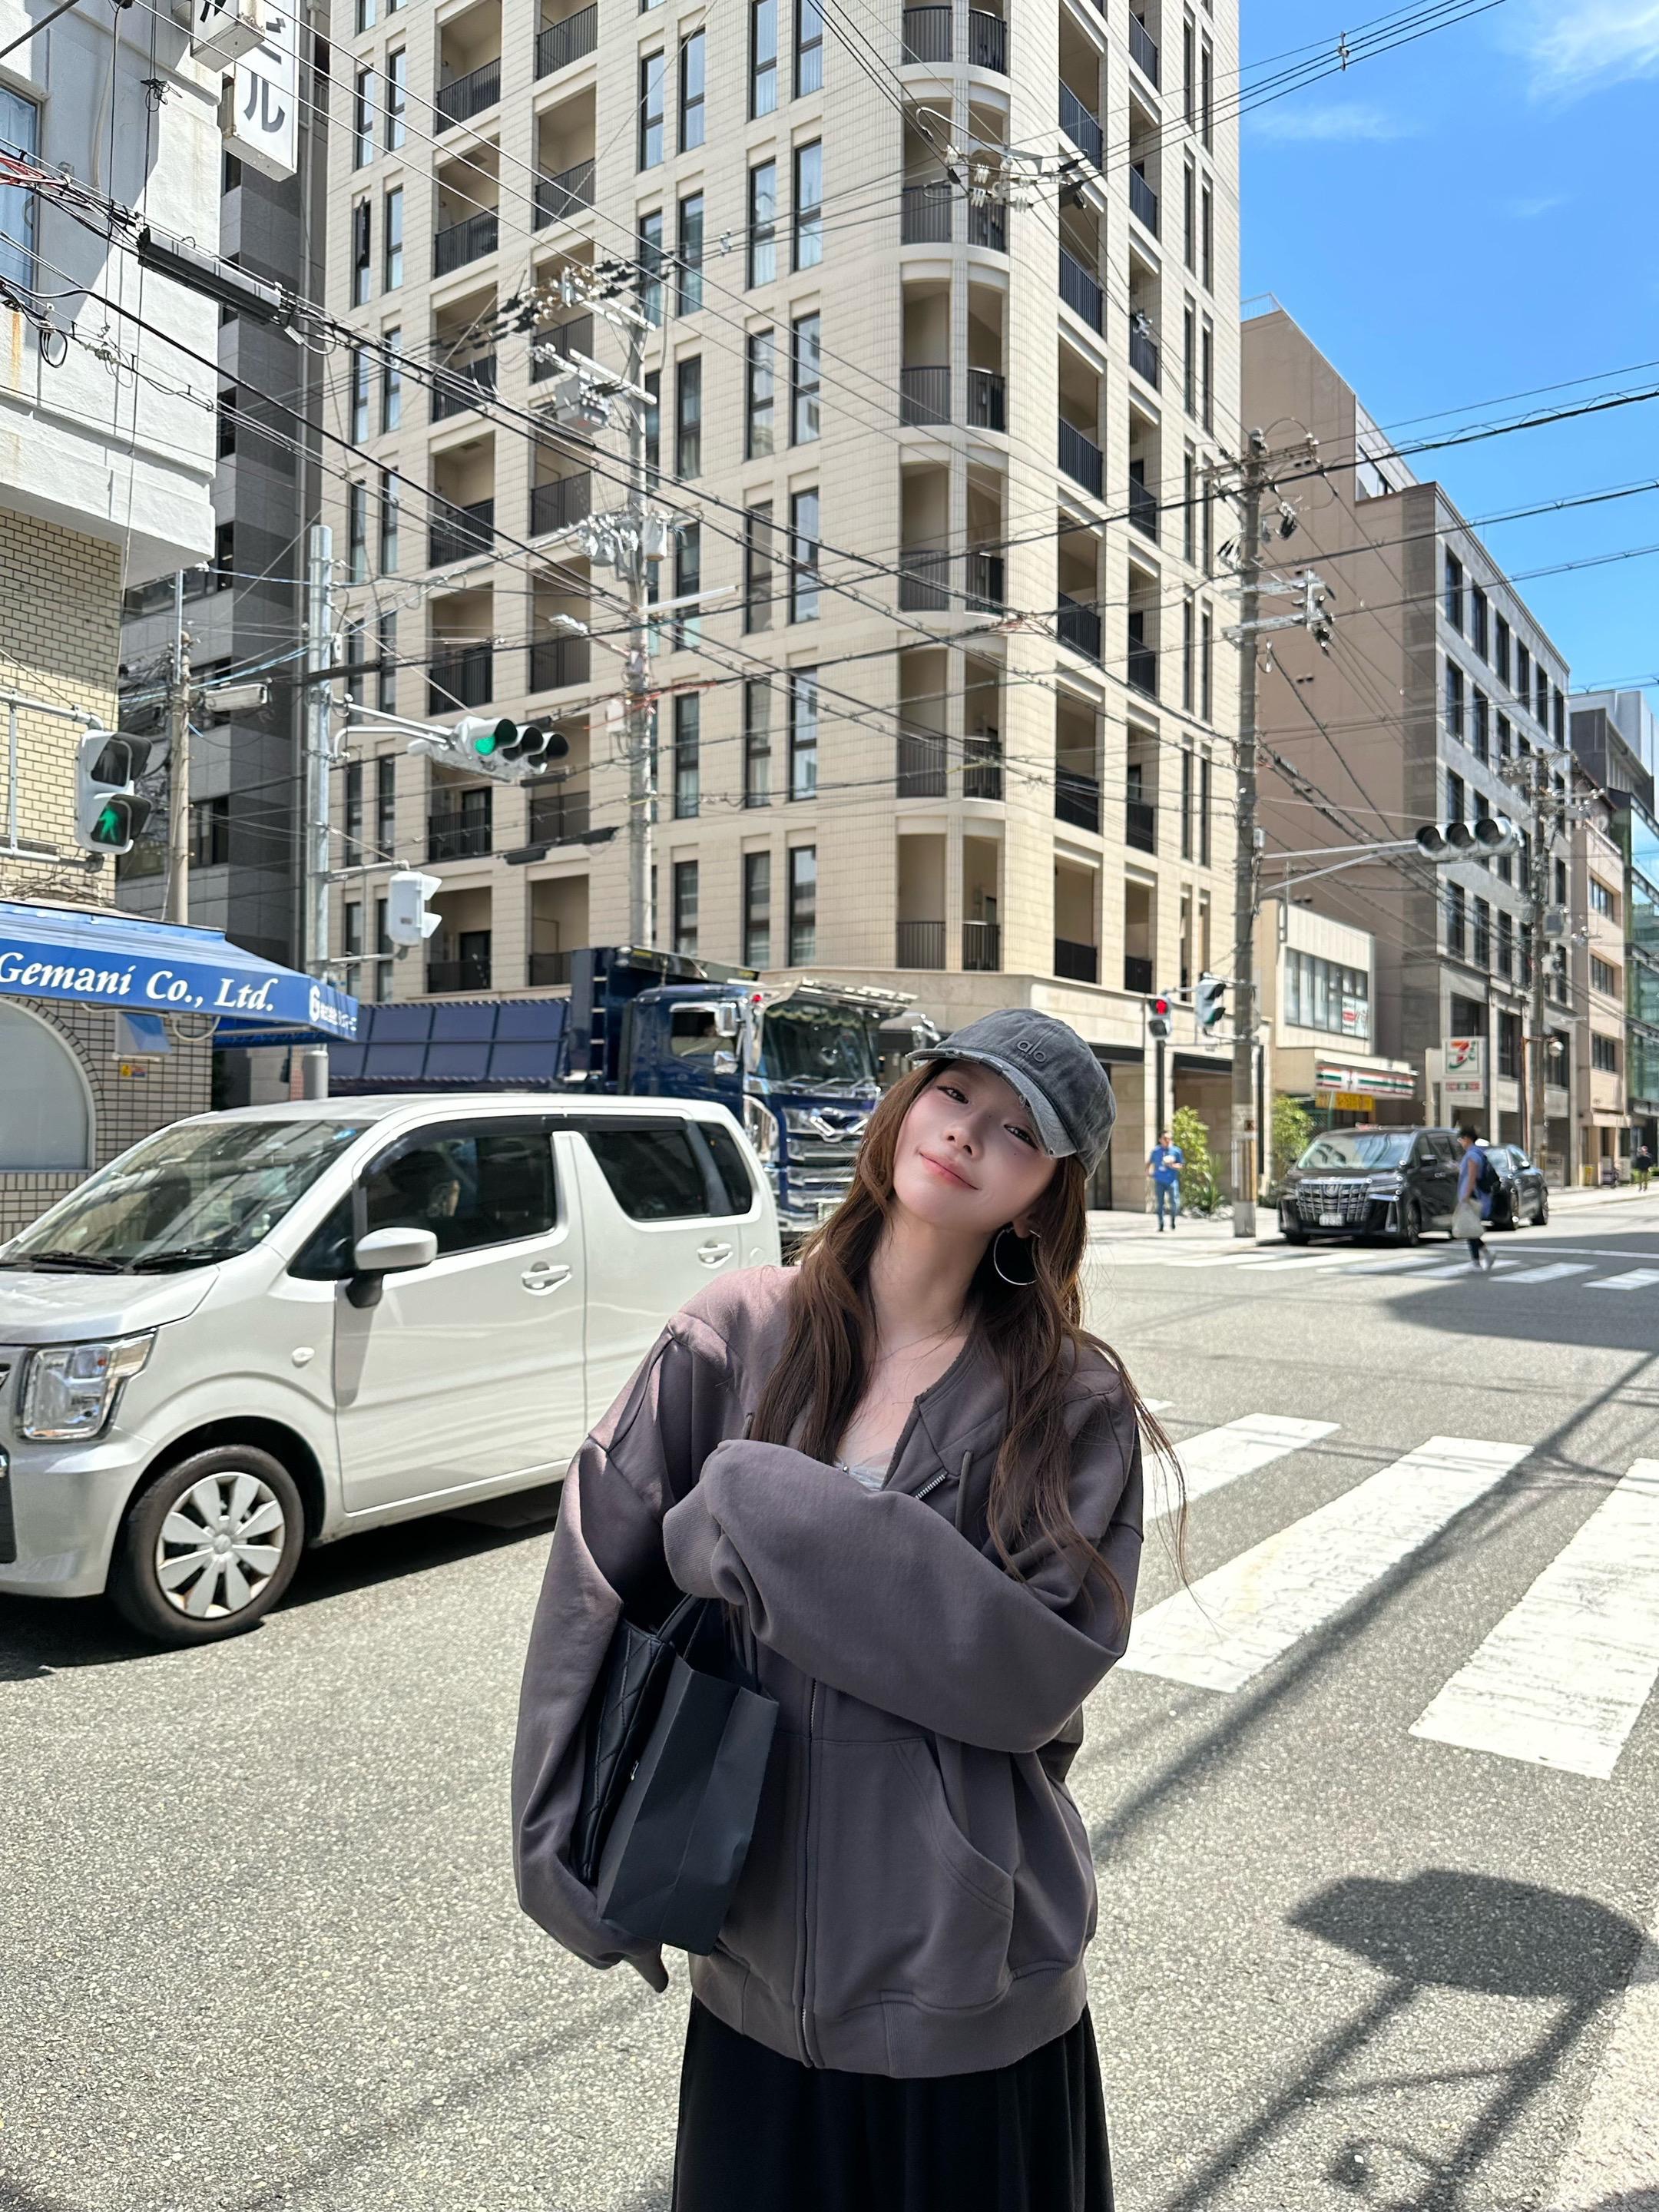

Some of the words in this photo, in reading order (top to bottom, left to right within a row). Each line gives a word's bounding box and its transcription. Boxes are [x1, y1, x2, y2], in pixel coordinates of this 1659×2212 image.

[0, 952, 137, 995] Gemani
[146, 970, 204, 1008] Co.,
[213, 977, 280, 1012] Ltd.
[1016, 1039, 1047, 1063] alo
